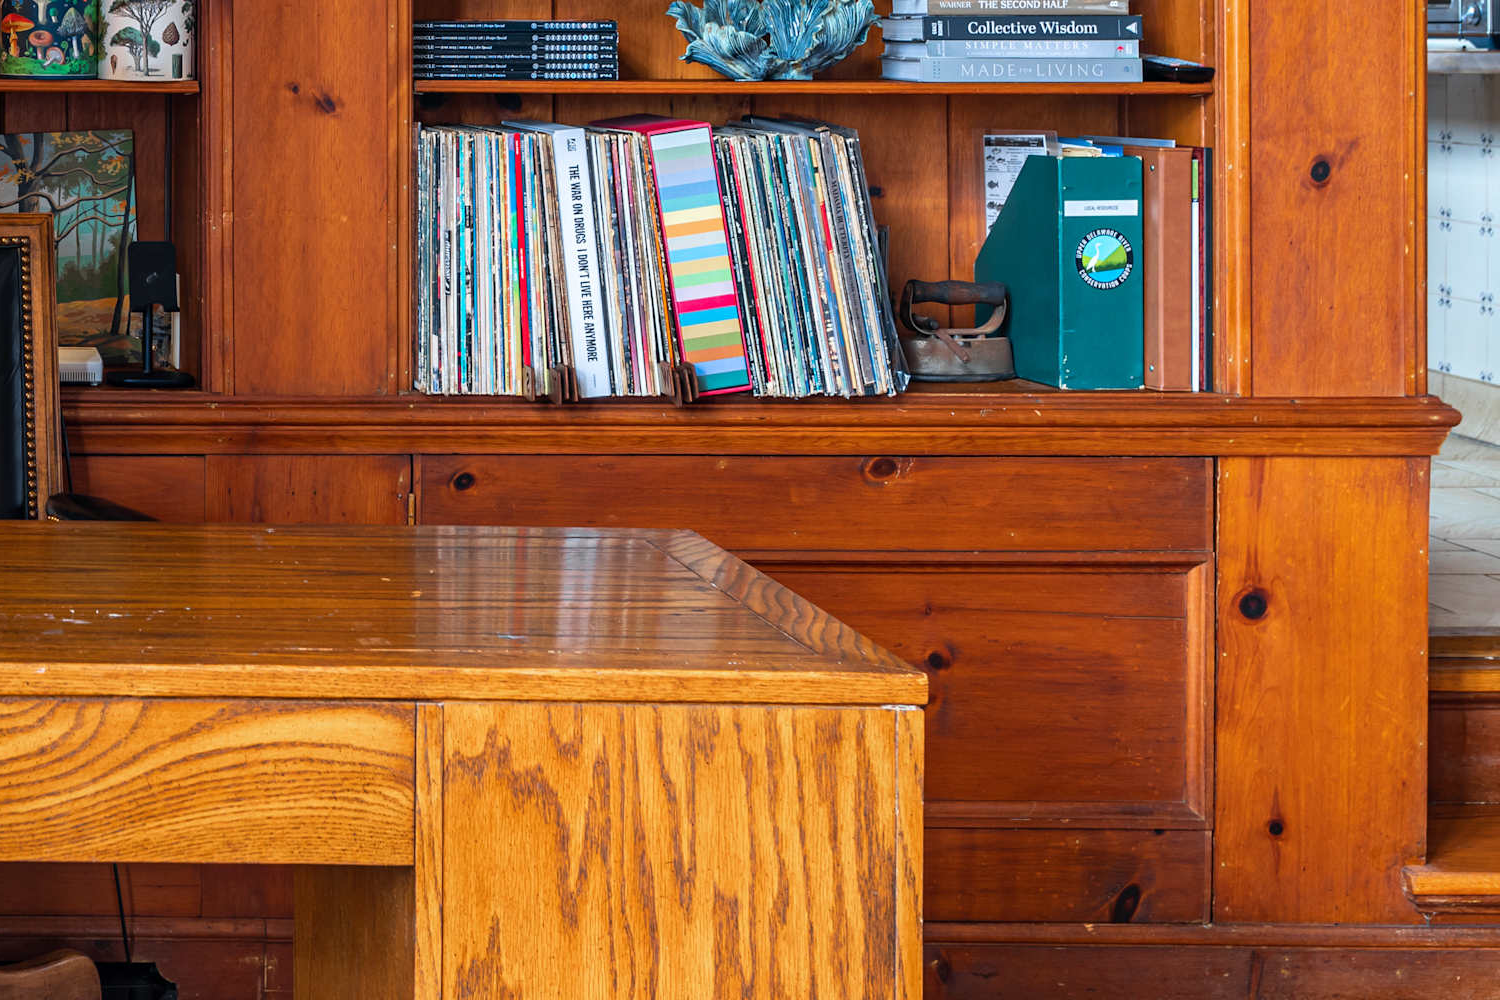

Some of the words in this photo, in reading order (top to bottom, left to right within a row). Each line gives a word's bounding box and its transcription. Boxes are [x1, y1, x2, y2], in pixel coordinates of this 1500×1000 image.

[939, 1, 972, 9] WARNER
[978, 0, 999, 9] THE
[1000, 0, 1040, 9] SECOND
[1042, 0, 1068, 9] HALF
[967, 21, 1037, 35] Collective
[1040, 21, 1098, 35] Wisdom
[961, 63, 1016, 77] MADE
[1036, 63, 1104, 77] LIVING
[569, 164, 580, 180] THE
[570, 182, 582, 201] WAR
[572, 203, 583, 215] ON
[573, 217, 586, 244] DRUGS
[1076, 239, 1088, 258] UPPER
[1086, 229, 1118, 241] DELAWARE
[1118, 235, 1132, 252] RIVER
[577, 254, 590, 279] DON'T
[1079, 269, 1119, 290] CONSERVATION
[1119, 264, 1133, 282] CORPS
[580, 281, 592, 298] LIVE
[581, 300, 594, 320] HERE
[584, 322, 598, 362] ANYMORE
